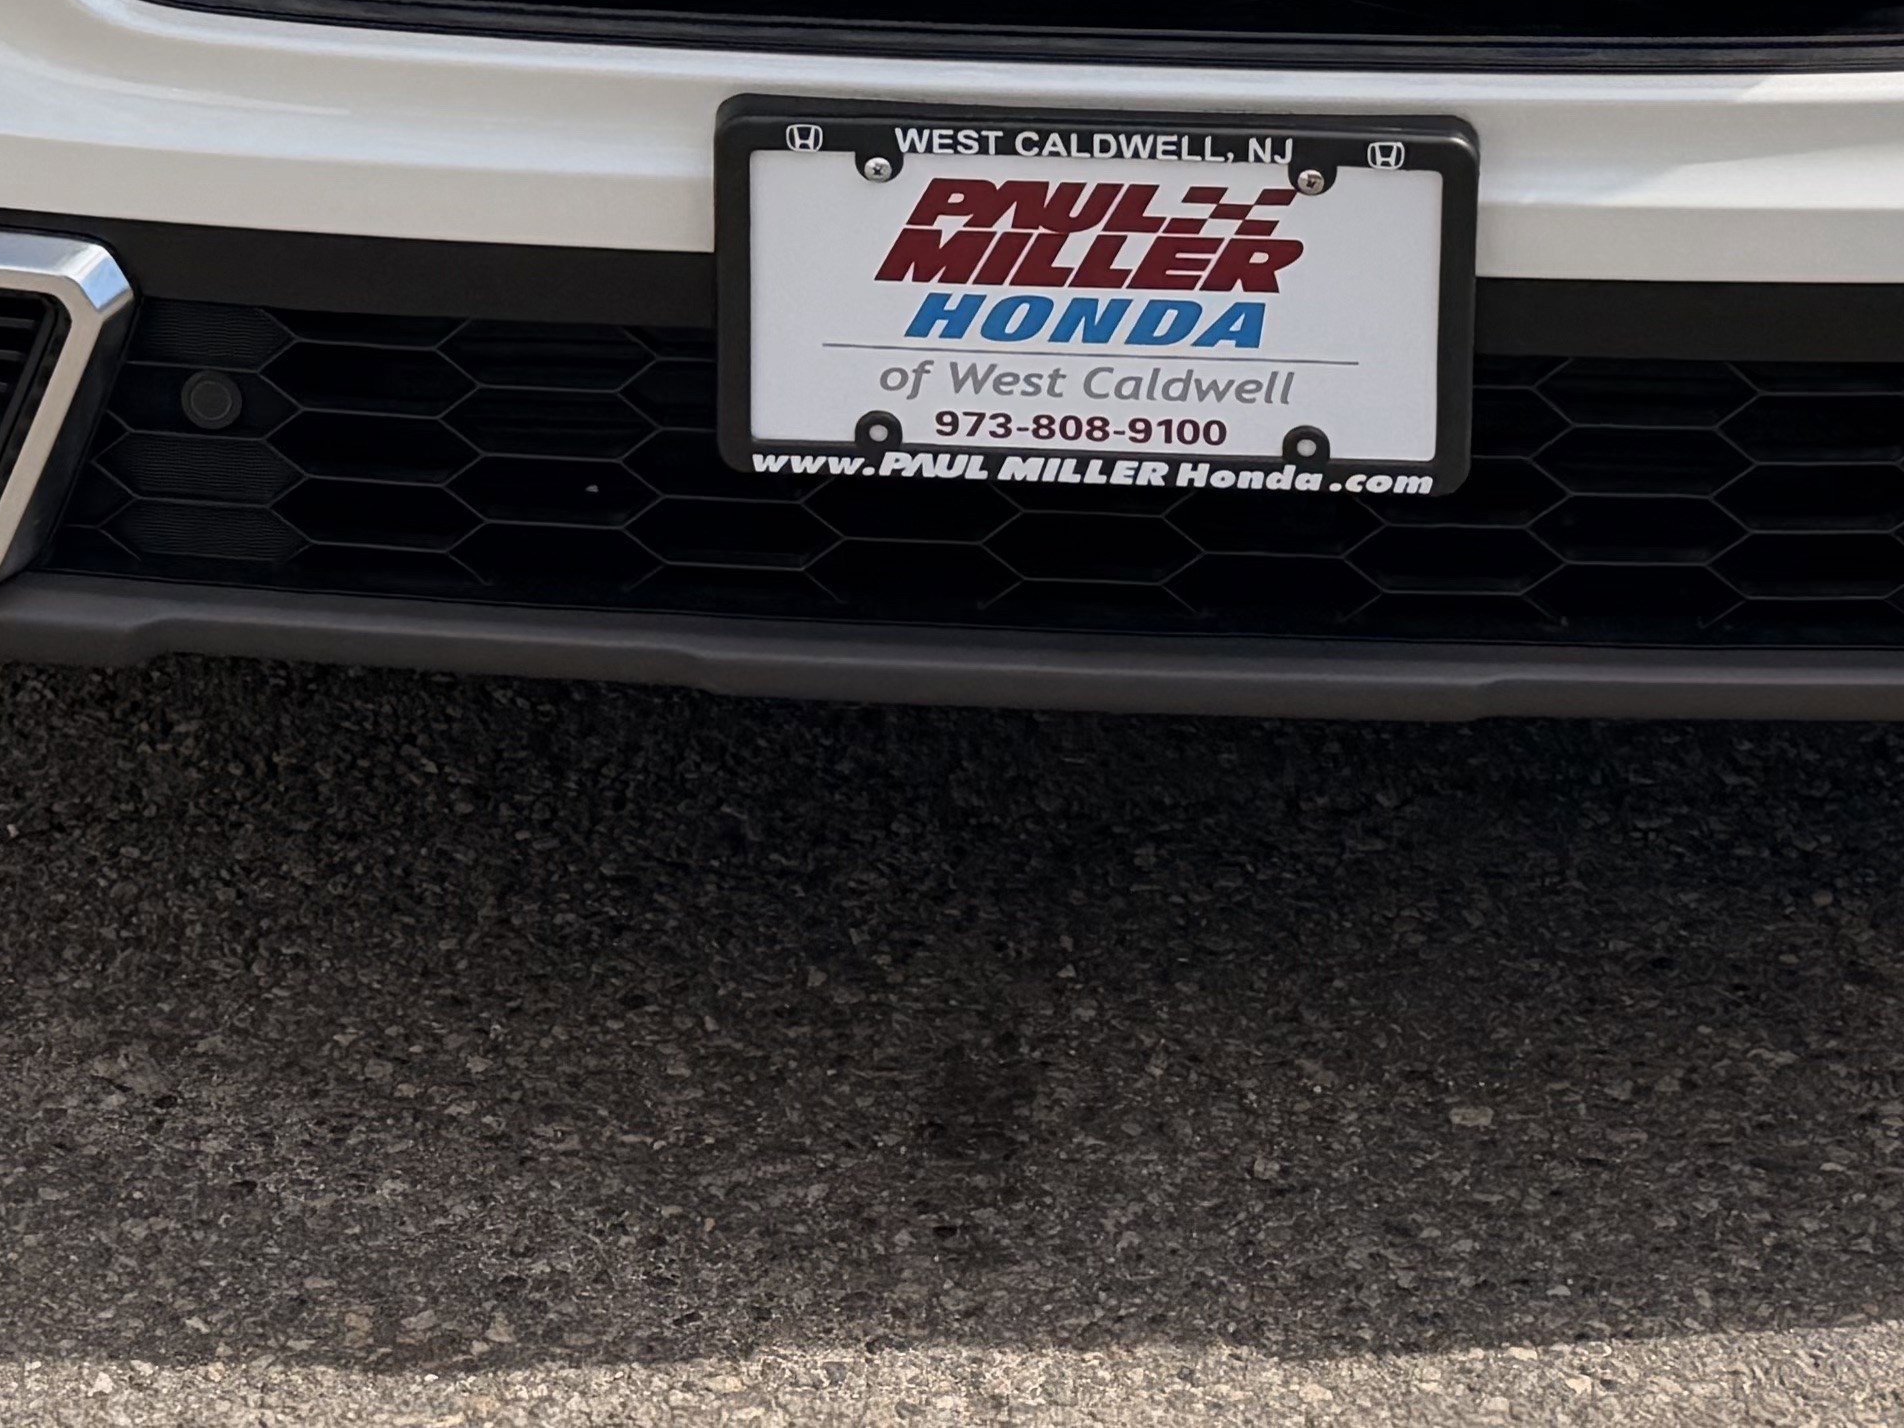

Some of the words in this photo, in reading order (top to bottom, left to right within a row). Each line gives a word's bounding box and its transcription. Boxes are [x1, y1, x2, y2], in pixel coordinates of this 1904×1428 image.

[895, 127, 1004, 156] WEST
[1014, 131, 1235, 163] CALDWELL,
[1247, 137, 1294, 165] NJ
[905, 177, 1168, 234] PAUL
[873, 228, 1305, 294] MILLER
[903, 292, 1267, 349] HONDA
[879, 360, 935, 400] of
[949, 361, 1067, 398] West
[1082, 366, 1295, 405] Caldwell
[934, 410, 1228, 446] 973-808-9100
